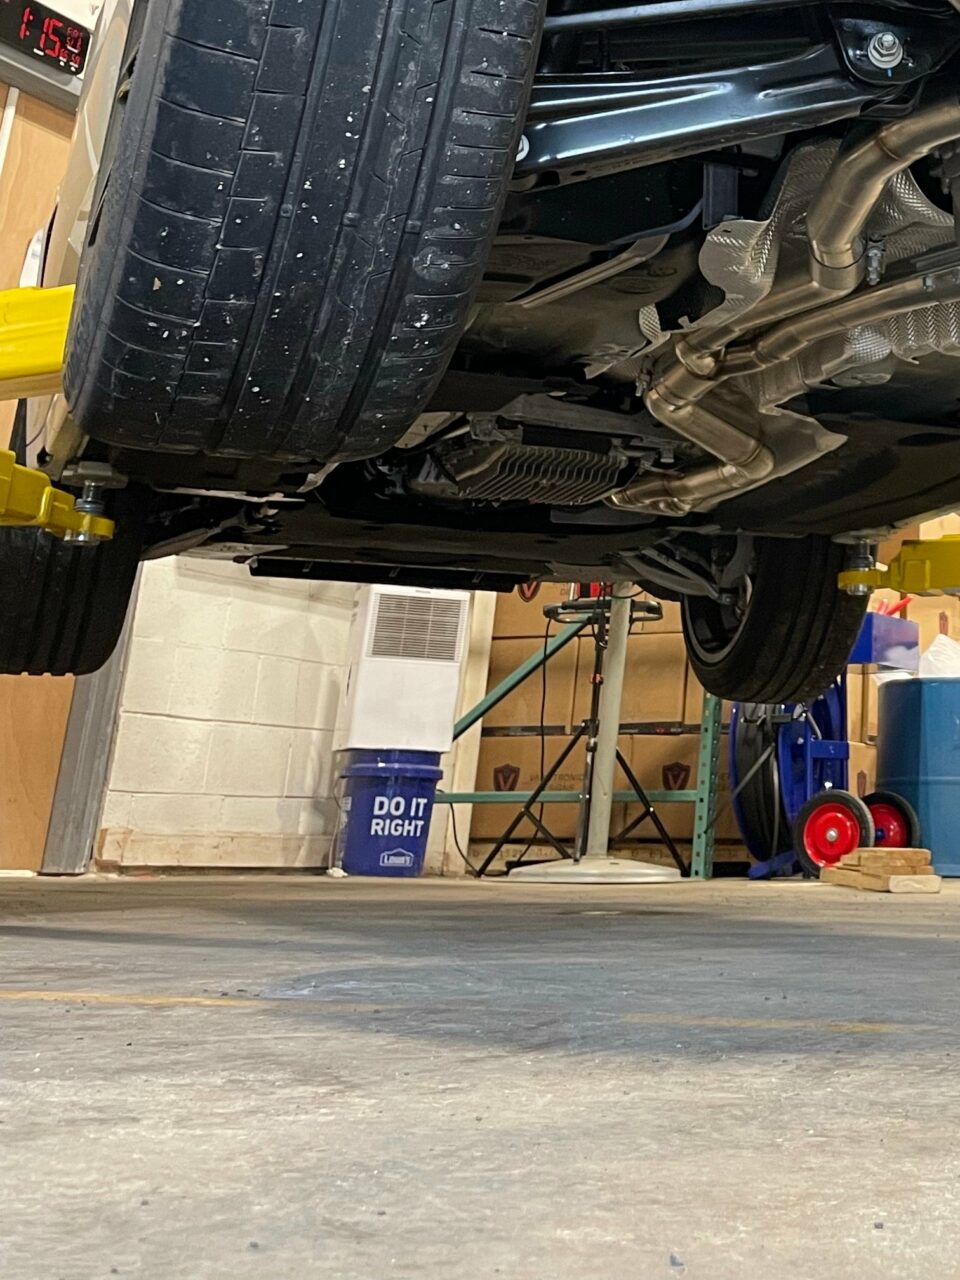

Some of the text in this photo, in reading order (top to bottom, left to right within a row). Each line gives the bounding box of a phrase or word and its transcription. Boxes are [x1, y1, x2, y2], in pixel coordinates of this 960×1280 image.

[20, 7, 64, 58] 1:15
[373, 796, 428, 817] DO IT
[370, 818, 425, 837] RIGHT
